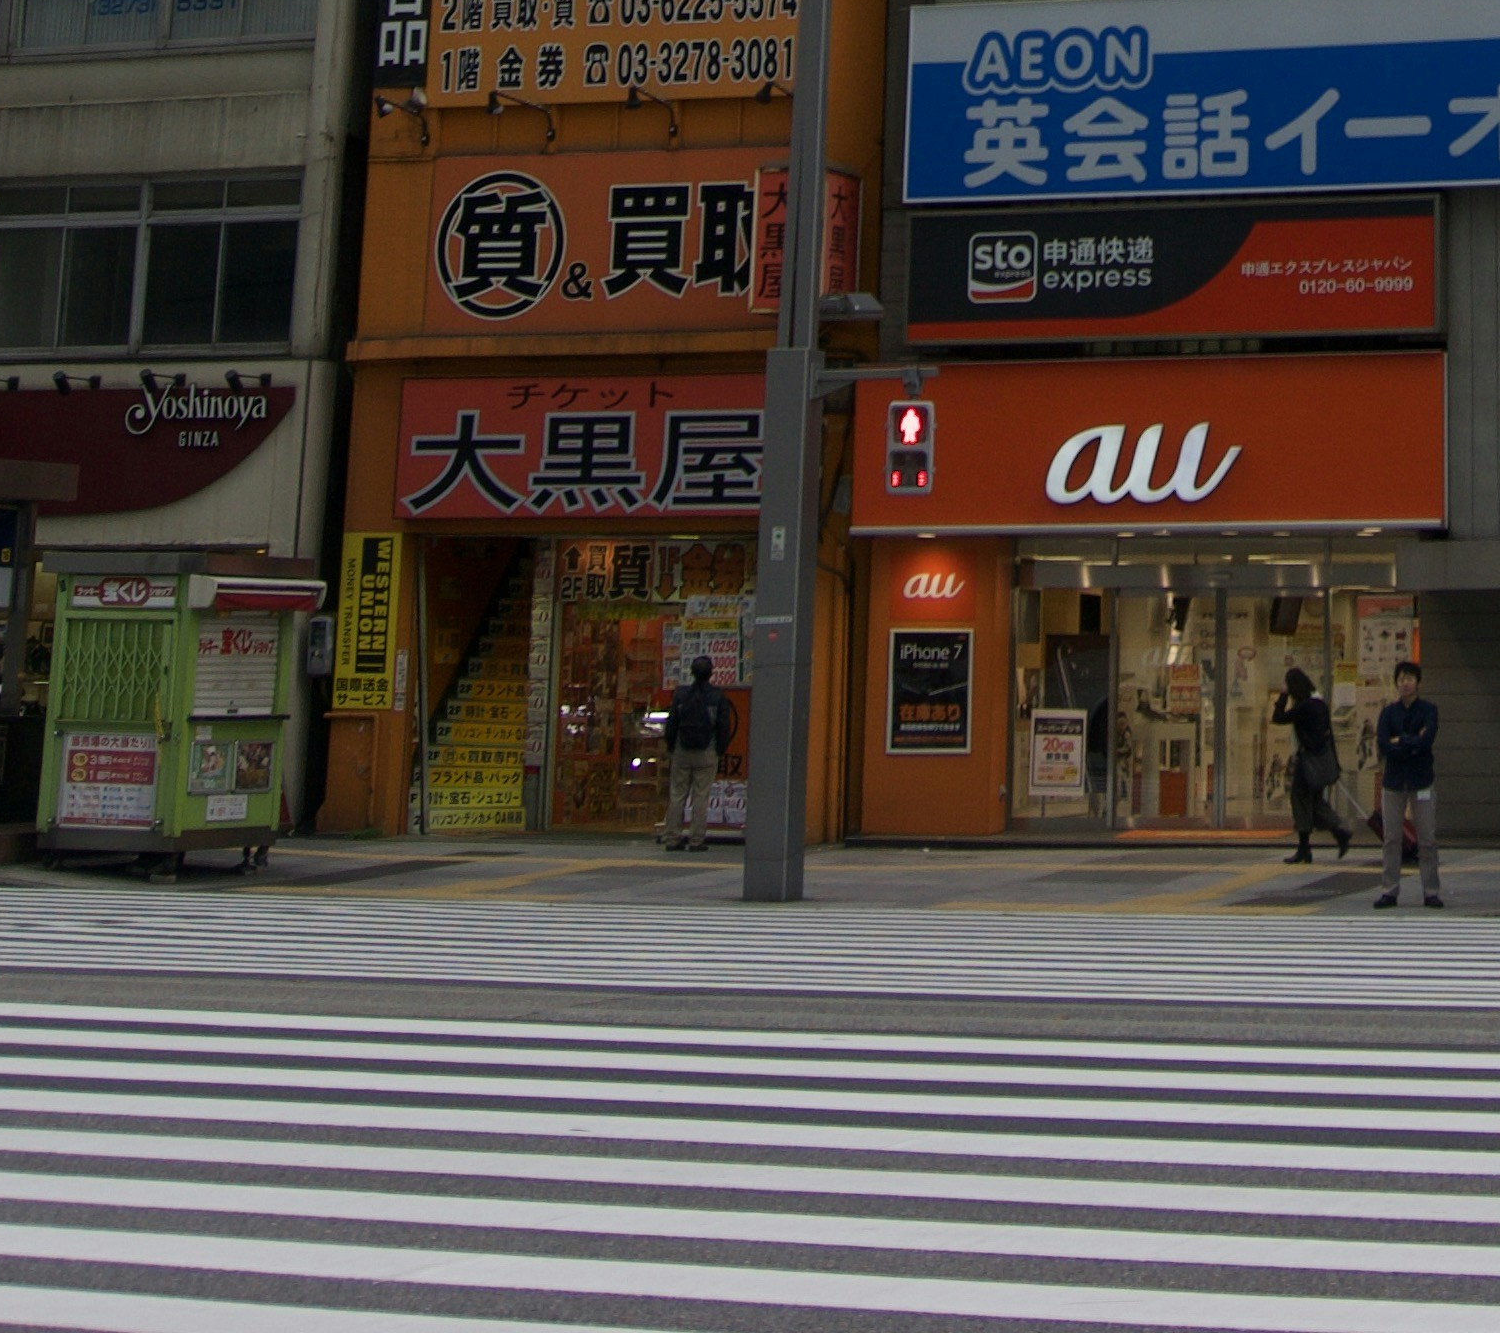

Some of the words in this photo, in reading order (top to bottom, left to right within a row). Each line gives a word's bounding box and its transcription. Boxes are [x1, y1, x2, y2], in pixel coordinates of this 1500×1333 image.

[441, 47, 480, 93] 1階
[497, 45, 564, 91] 金券
[616, 36, 794, 86] 03-3278-3081
[972, 30, 1146, 86] AEON
[973, 238, 1030, 270] sto
[1043, 265, 1152, 291] express
[1298, 276, 1413, 295] 0120-60-9999
[125, 384, 268, 436] Yoshinoya
[507, 381, 674, 410] チケット
[178, 430, 220, 448] GINZA
[401, 409, 765, 516] 大黒屋
[1044, 421, 1243, 506] au
[371, 540, 392, 651] WESTERN
[561, 577, 583, 599] 2F
[902, 572, 965, 599] au
[357, 573, 376, 651] UNION
[900, 643, 950, 661] iPhone
[953, 643, 963, 660] 7
[337, 693, 386, 705] サービス
